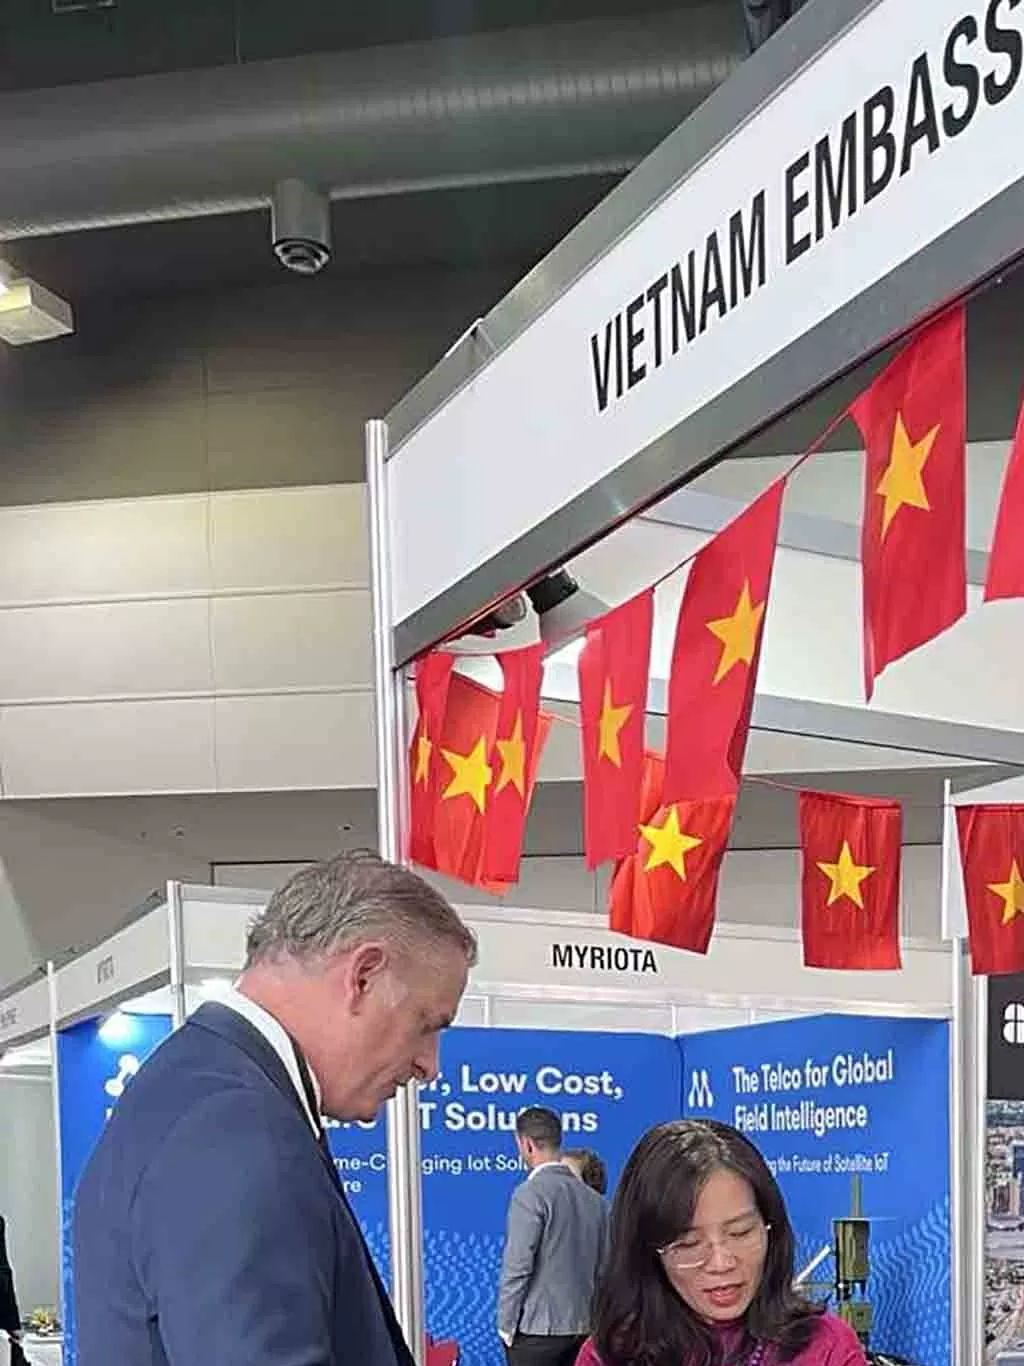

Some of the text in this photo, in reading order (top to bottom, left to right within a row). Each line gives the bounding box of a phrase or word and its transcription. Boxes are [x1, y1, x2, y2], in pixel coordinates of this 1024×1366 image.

[590, 188, 768, 412] VIETNAM
[552, 943, 657, 973] MYRIOTA
[461, 1064, 528, 1093] Low
[535, 1065, 624, 1099] Cost,
[733, 1049, 894, 1094] The Telco for Global
[735, 1099, 868, 1138] Field Intelligence
